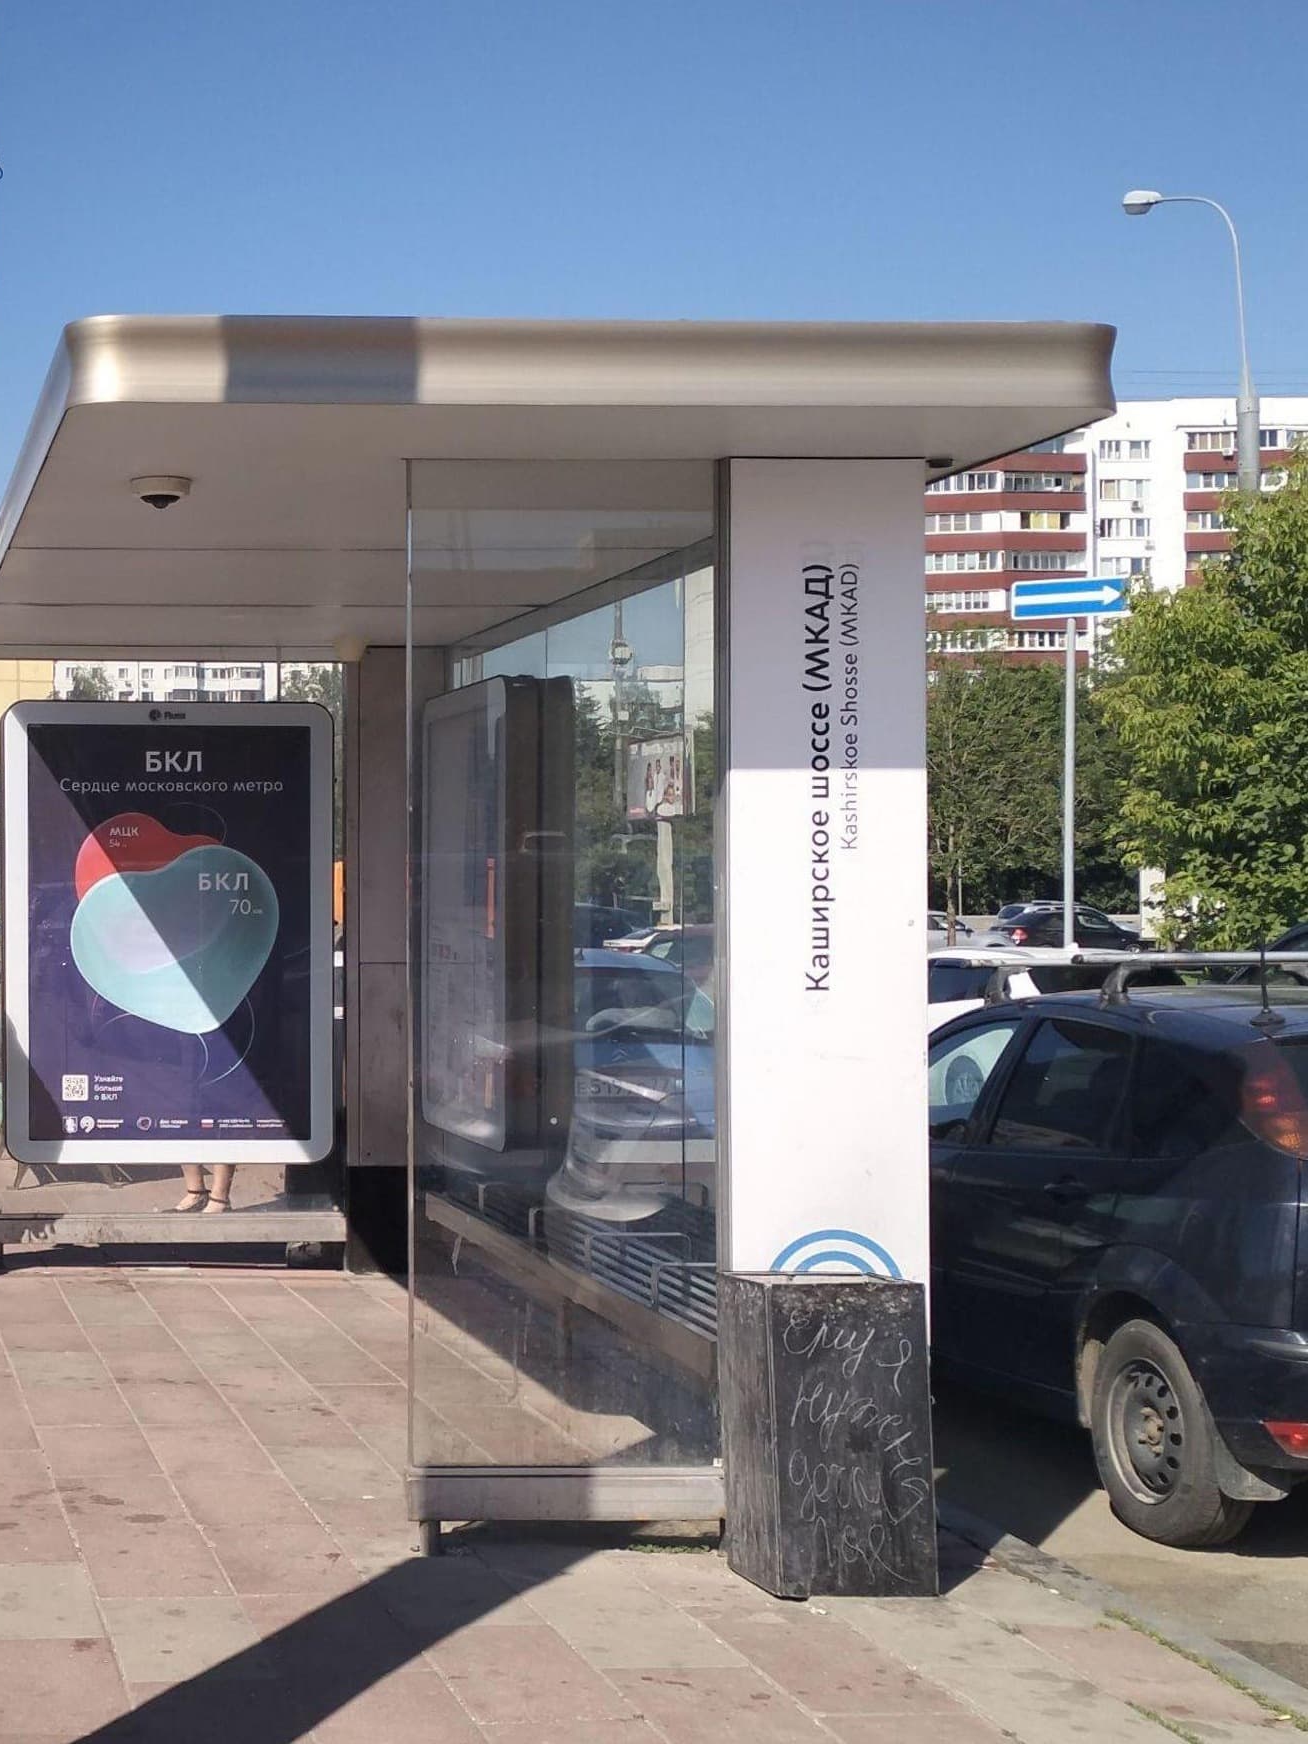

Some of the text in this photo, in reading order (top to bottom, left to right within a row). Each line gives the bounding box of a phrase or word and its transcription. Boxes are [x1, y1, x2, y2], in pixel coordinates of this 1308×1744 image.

[839, 564, 859, 850] Kashirskoe Shosse (MKAD)
[145, 751, 203, 773] БКЛ
[59, 777, 284, 795] Сердце московского метро
[802, 564, 836, 991] Каширское шоссе (МКАД)
[109, 827, 139, 837] МЦК
[198, 873, 249, 891] БКЛ
[229, 899, 252, 915] 70
